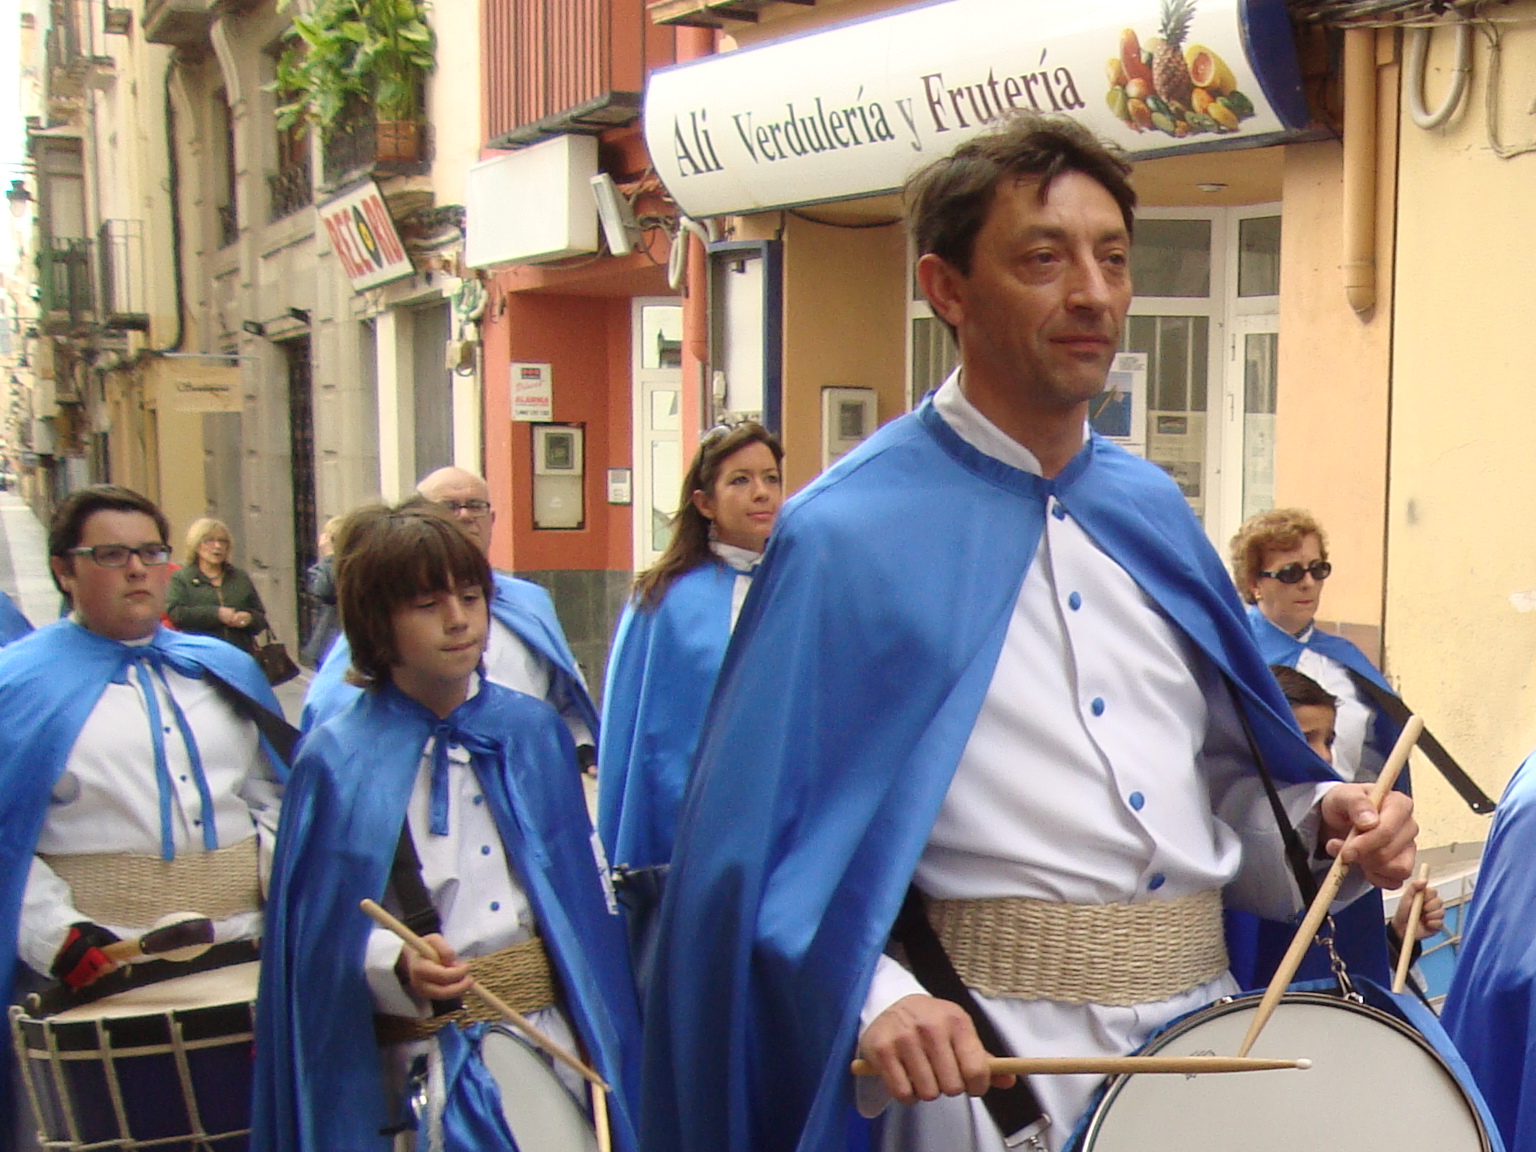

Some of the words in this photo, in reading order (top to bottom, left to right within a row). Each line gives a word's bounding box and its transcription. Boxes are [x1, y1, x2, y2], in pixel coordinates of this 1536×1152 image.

[732, 85, 895, 164] Verdulería
[895, 98, 922, 151] y
[920, 47, 1086, 133] Frutería
